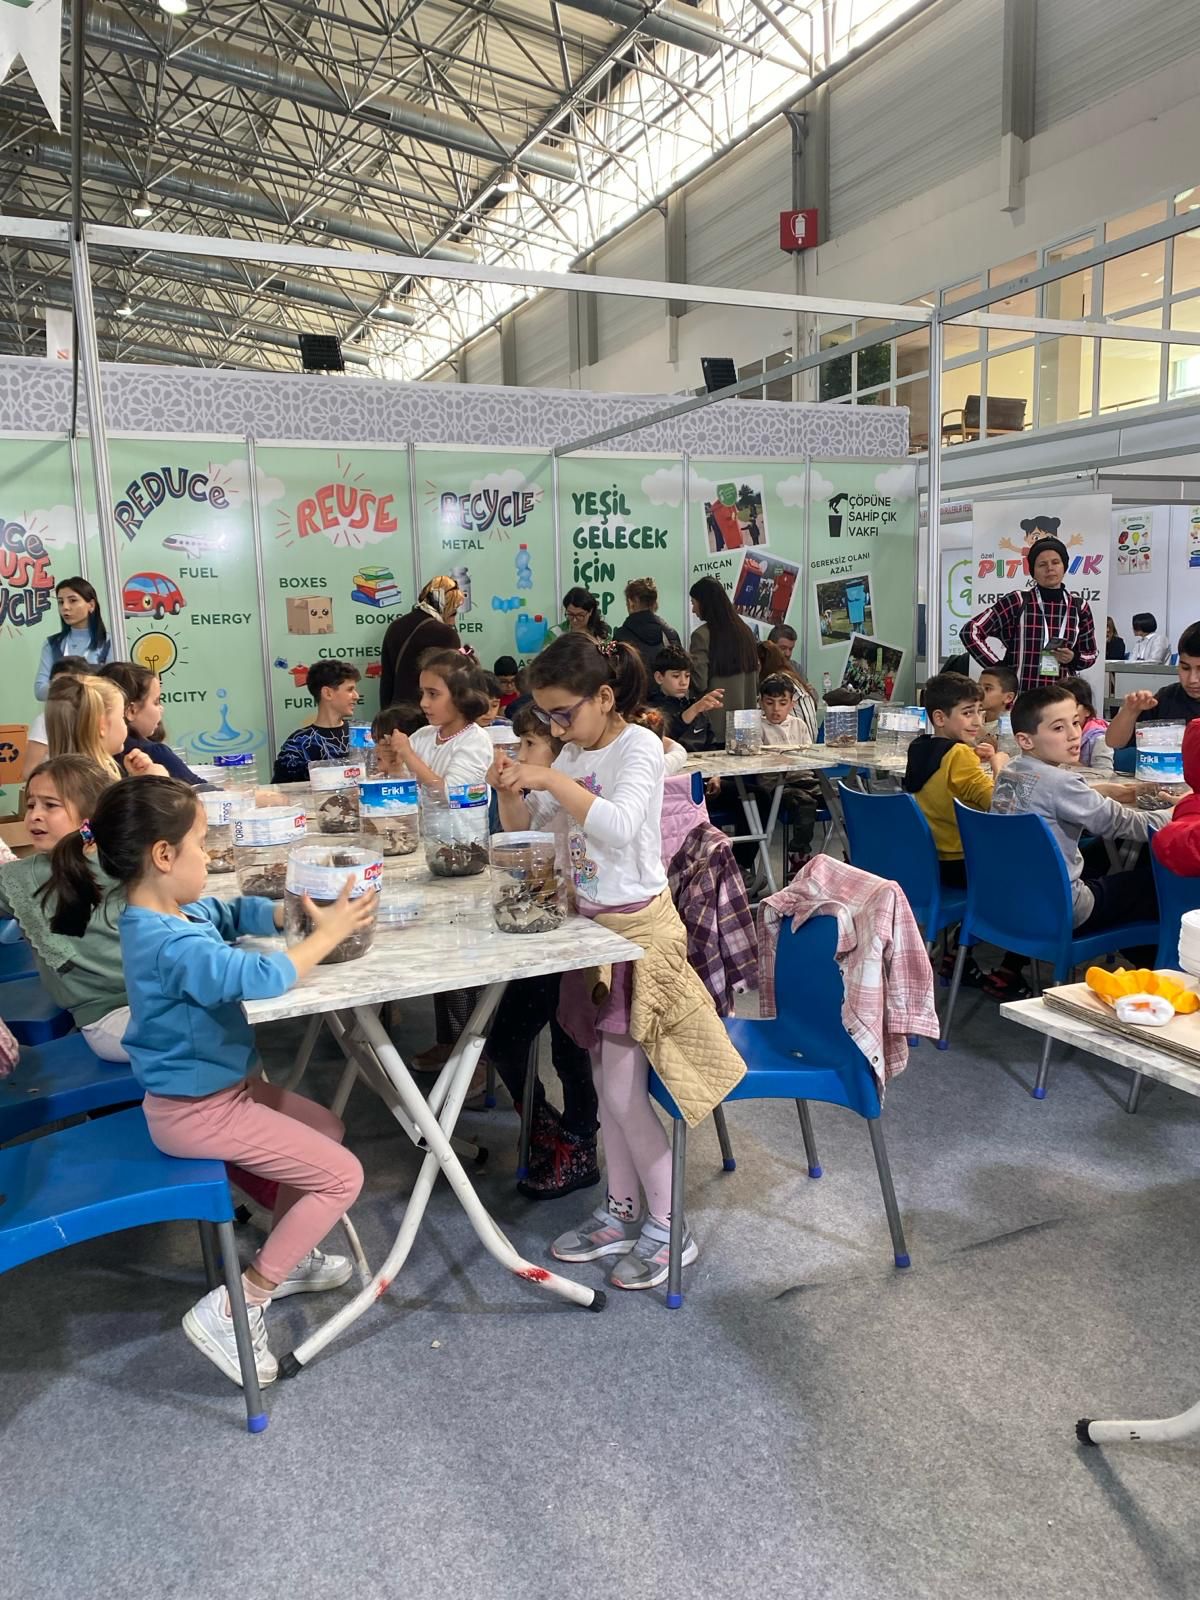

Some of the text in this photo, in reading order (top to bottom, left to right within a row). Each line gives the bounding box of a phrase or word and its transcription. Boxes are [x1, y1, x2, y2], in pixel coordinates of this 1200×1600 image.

[572, 483, 631, 524] YEŞİL
[849, 494, 891, 509] ÇÖPÜNE
[296, 483, 398, 537] REUSE
[440, 489, 534, 532] RECYCLE
[848, 509, 897, 525] SAHİP ÇIK
[573, 526, 668, 549] GELECEK
[848, 527, 879, 537] VAKFI
[442, 539, 484, 550] METAL
[693, 559, 732, 573] ATIKCAN
[810, 552, 870, 569] GEREKSİZ OLANI
[179, 567, 218, 579] FUEL
[573, 551, 615, 590] İÇİN
[830, 565, 853, 575] AZALT
[279, 577, 327, 589] BOXES
[191, 613, 252, 625] ENERGY
[318, 646, 382, 659] CLOTHES
